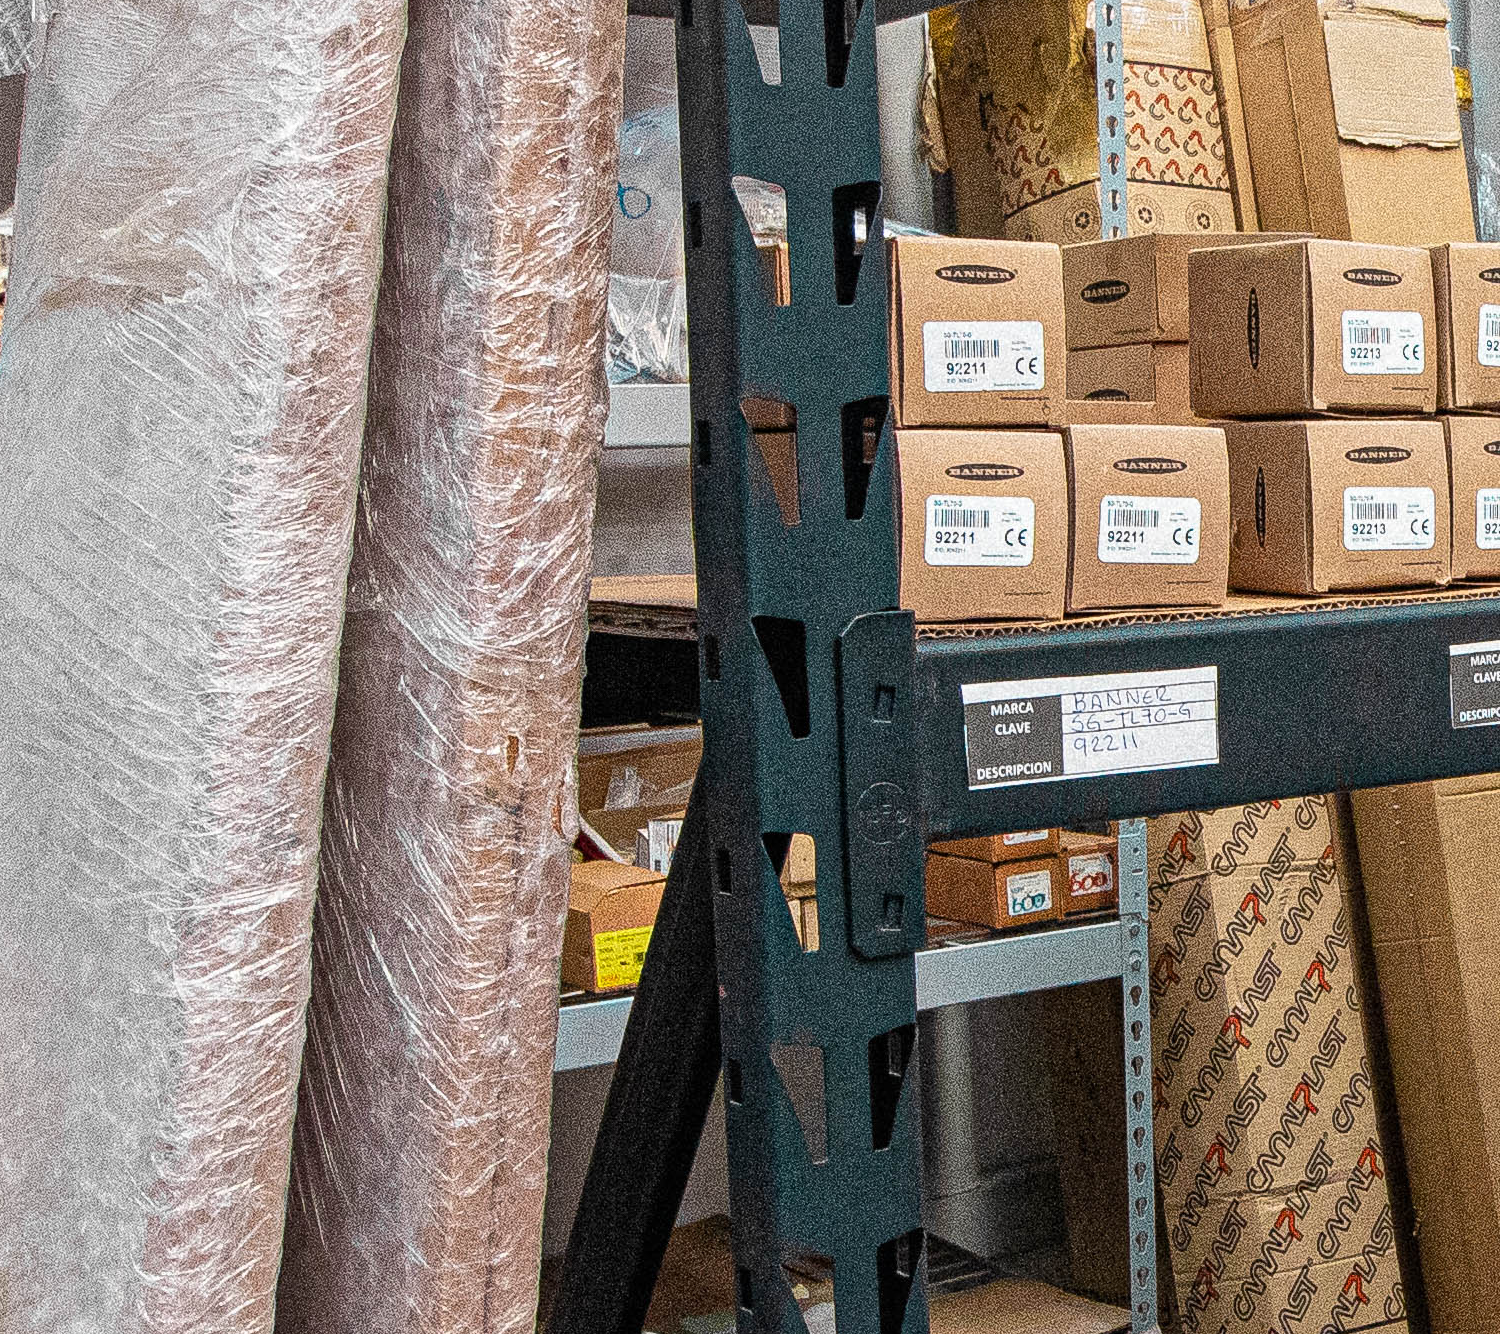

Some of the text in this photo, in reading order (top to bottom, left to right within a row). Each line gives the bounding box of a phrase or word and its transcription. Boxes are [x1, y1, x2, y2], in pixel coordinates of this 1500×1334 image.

[941, 268, 1011, 282] BANNER
[1345, 270, 1401, 284] BANNER
[1349, 346, 1382, 360] 92213
[945, 361, 986, 376] 92211
[1347, 447, 1410, 462] BANNER
[949, 465, 1021, 479] BANNER
[1116, 458, 1184, 473] BANNER
[1107, 529, 1145, 544] 92211
[1351, 522, 1387, 536] 92213
[935, 530, 975, 545] 92211
[990, 685, 1173, 716] MARCA BANNER
[994, 721, 1031, 736] CLAVE
[1073, 732, 1140, 754] 92211
[976, 761, 1052, 781] DESCRIPCION
